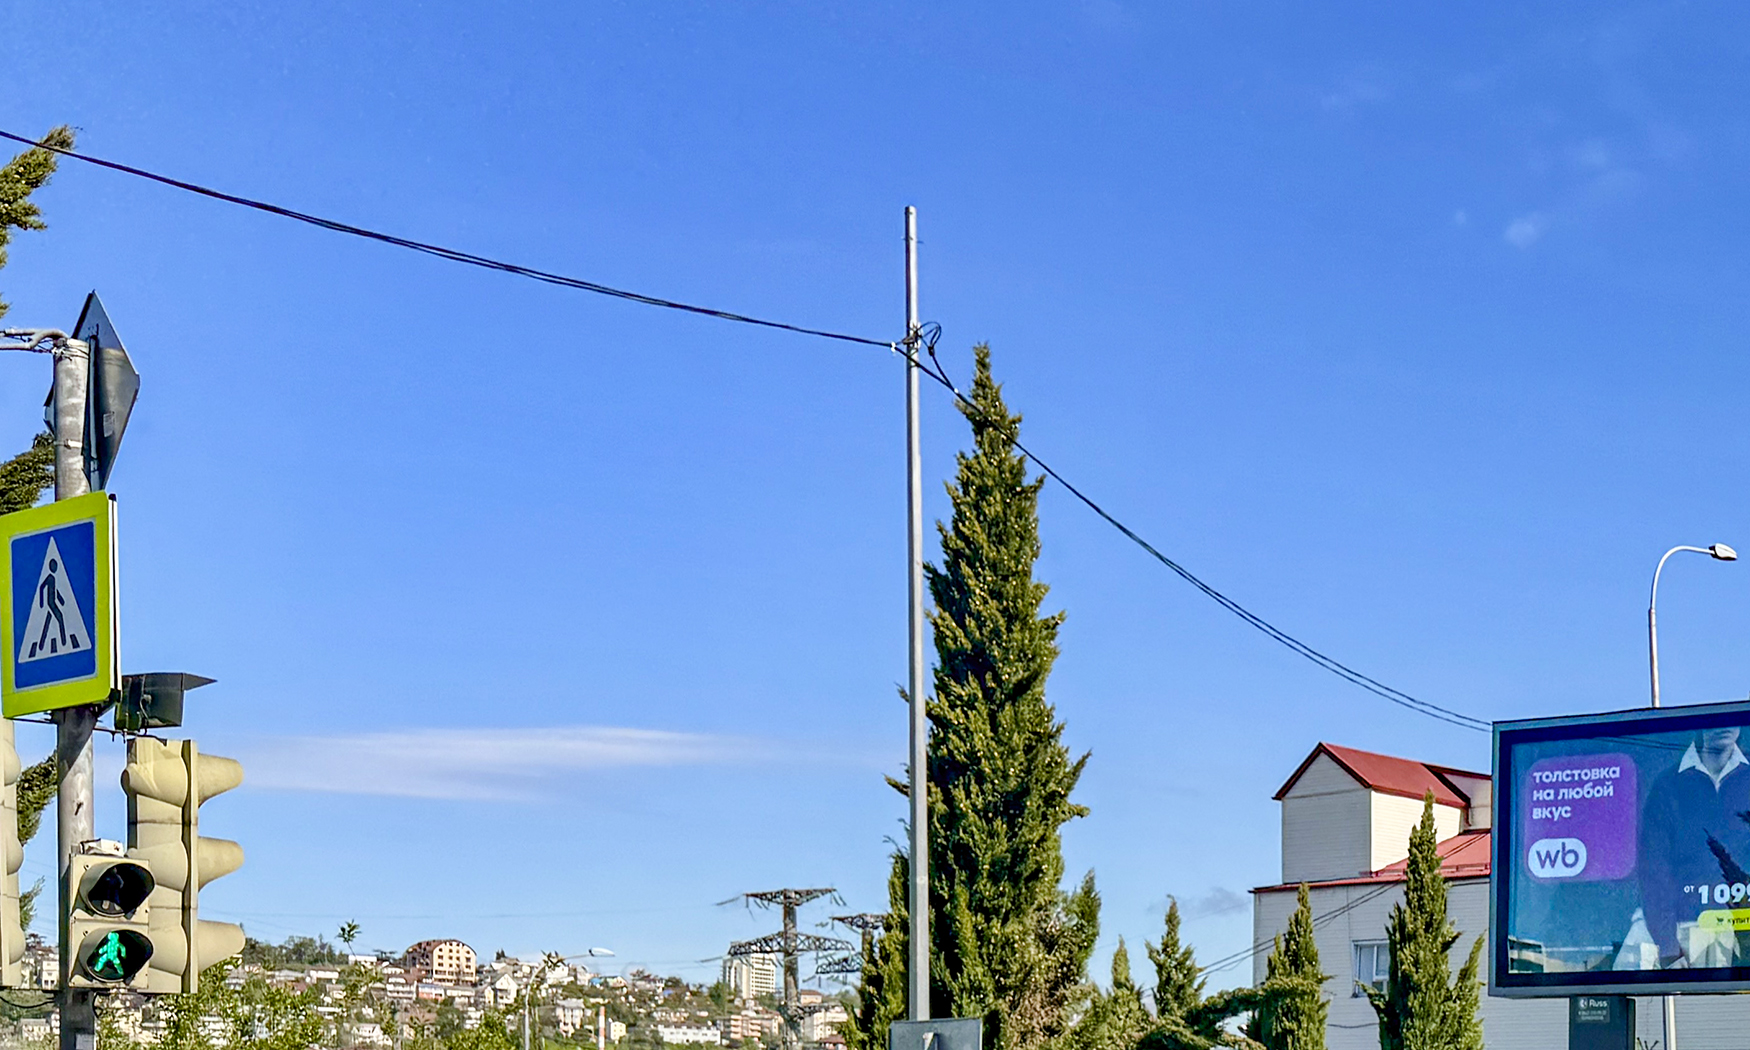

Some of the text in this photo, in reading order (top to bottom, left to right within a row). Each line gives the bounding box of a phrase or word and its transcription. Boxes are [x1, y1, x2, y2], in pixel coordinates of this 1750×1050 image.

[1533, 766, 1620, 783] толстовка
[1533, 781, 1613, 801] на любой
[1532, 806, 1571, 821] вкус
[1536, 841, 1580, 869] wb
[1683, 885, 1695, 893] от
